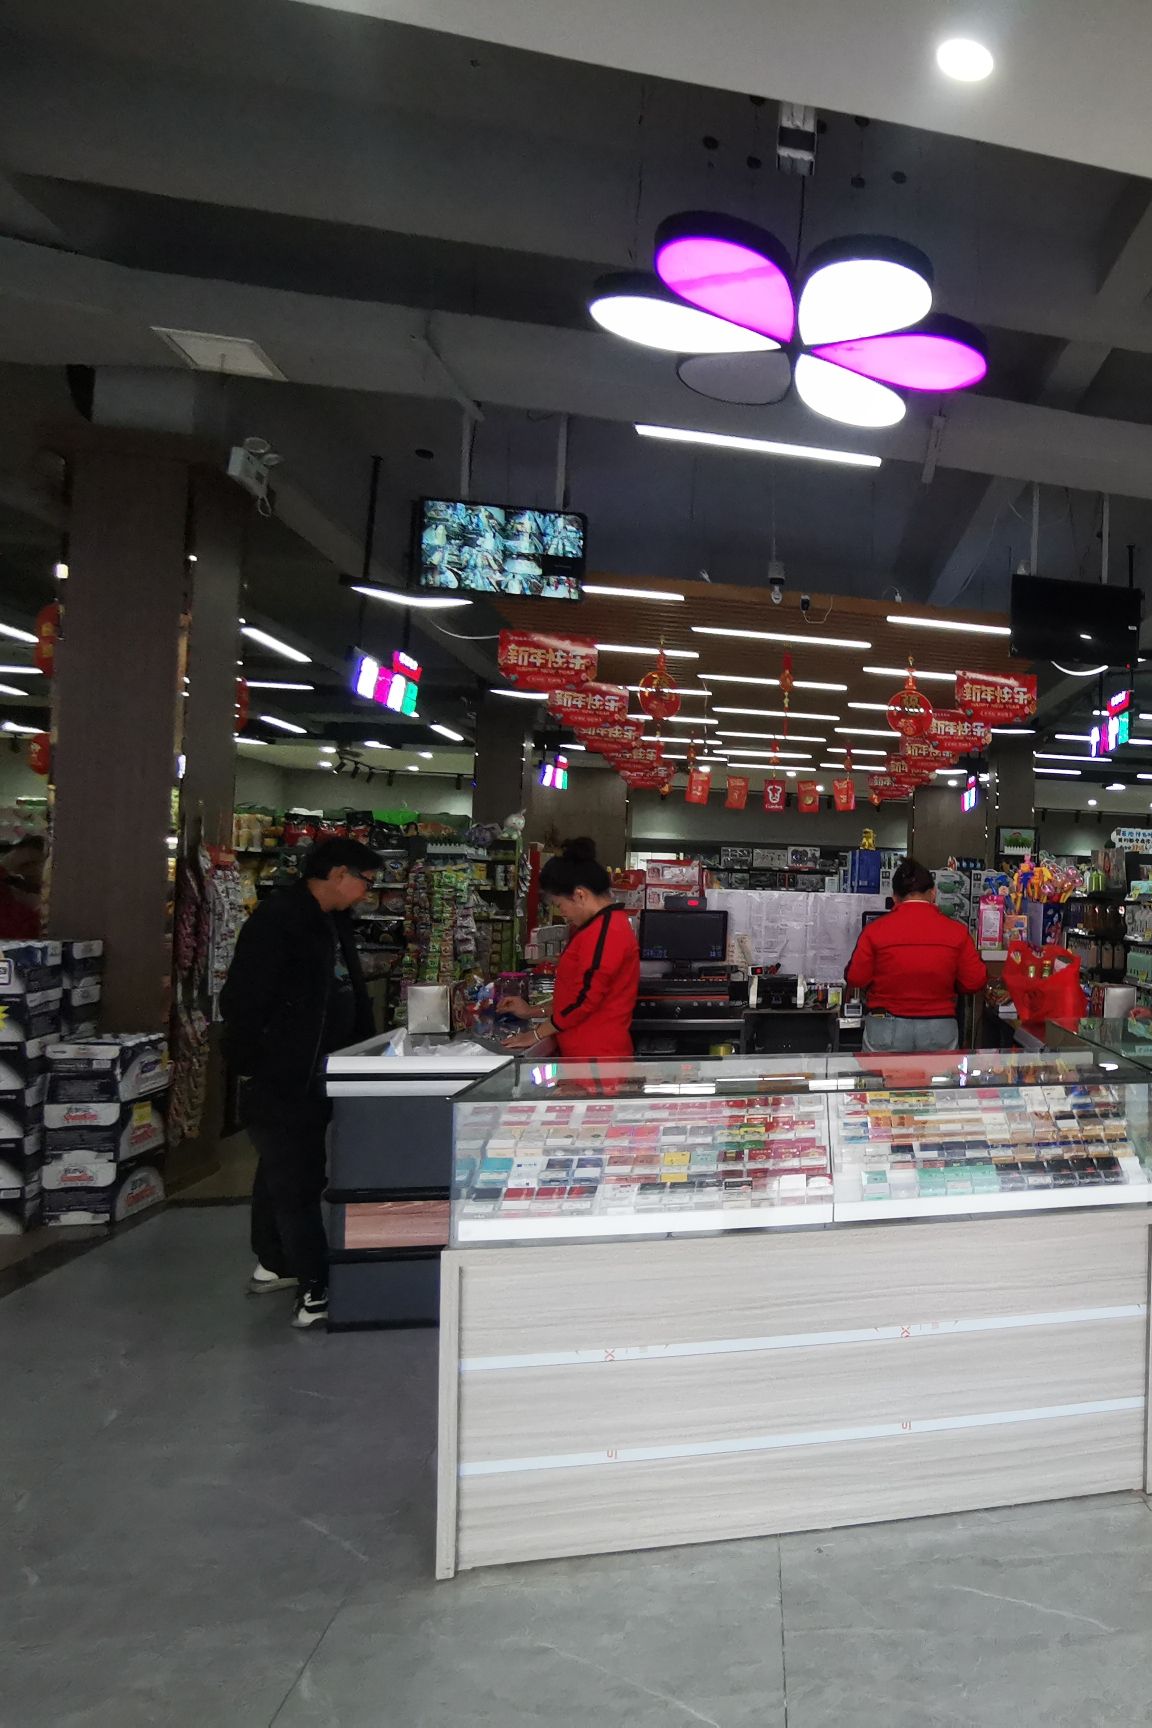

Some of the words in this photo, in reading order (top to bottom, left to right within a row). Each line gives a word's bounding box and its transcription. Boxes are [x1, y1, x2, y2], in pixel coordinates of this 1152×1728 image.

[507, 644, 586, 671] 新年快乐
[554, 689, 621, 712] 新年快乐
[964, 682, 1028, 705] 新年快乐
[931, 719, 986, 737] 新年快乐
